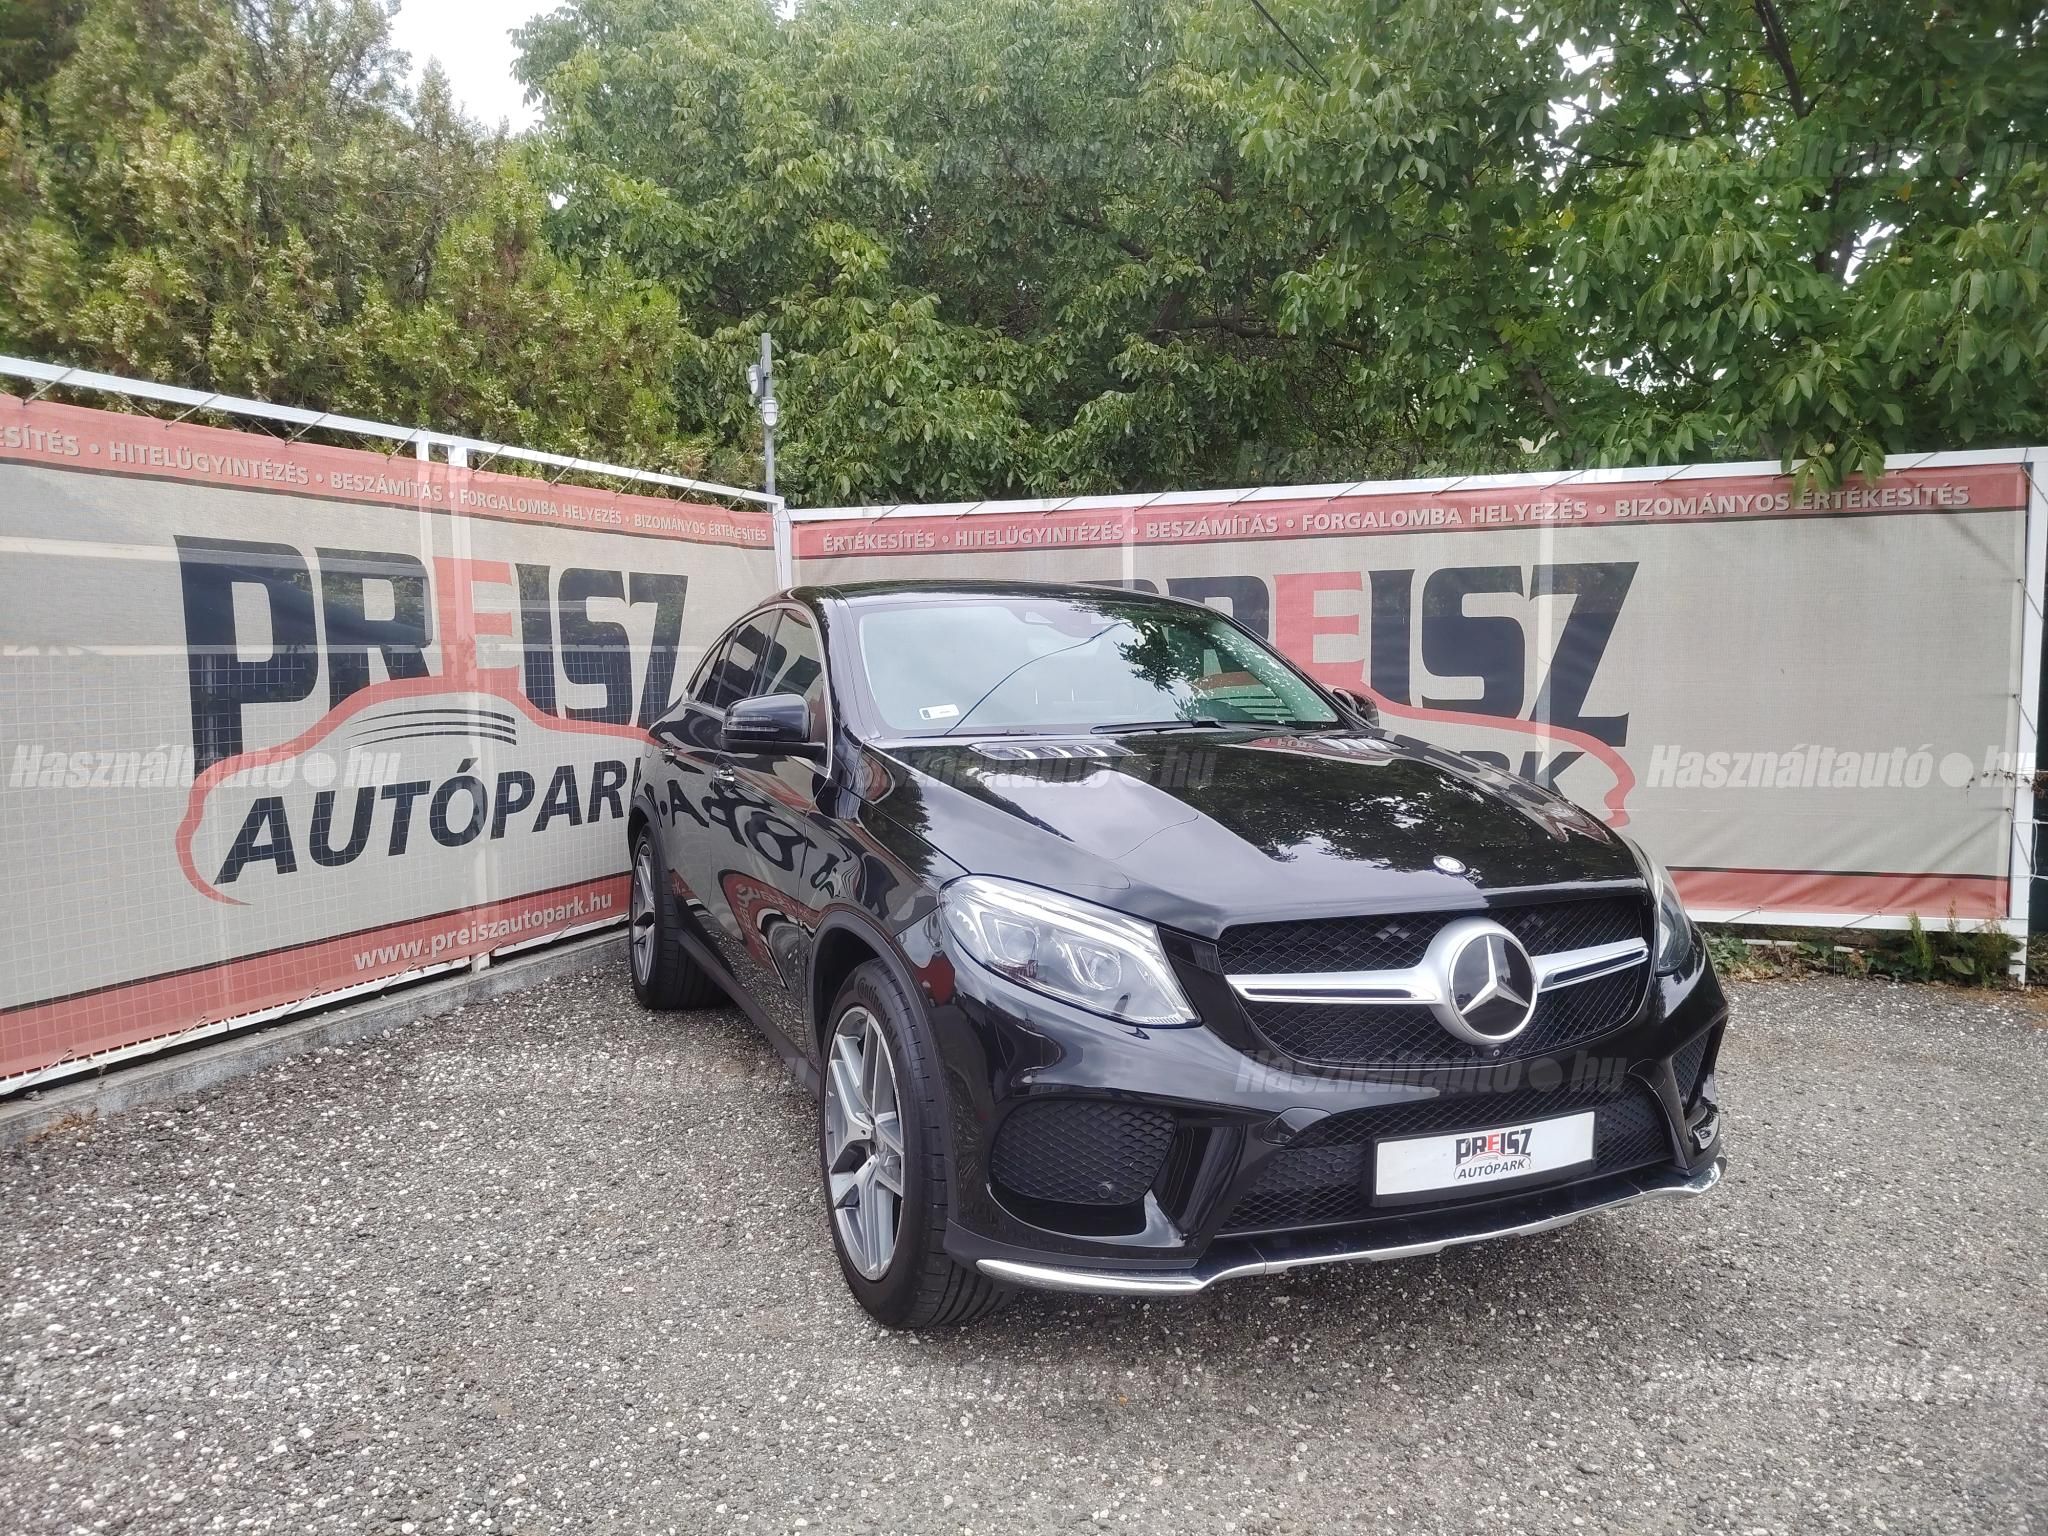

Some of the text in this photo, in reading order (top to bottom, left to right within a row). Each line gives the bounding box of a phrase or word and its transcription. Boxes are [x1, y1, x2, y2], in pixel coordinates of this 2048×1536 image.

[109, 441, 309, 486] HITELÜGYINTÉZÉS
[330, 470, 443, 501] BESZÁMÍTÁS
[459, 489, 560, 517] FORGALOMBA
[562, 504, 622, 525] HELYEZÉS
[634, 514, 706, 536] BIZOMÁNYOS
[708, 521, 767, 542] ÉRTÉKESÍTÉS
[823, 483, 1970, 553] ÉRTÉKESÍTÉS HITELÜGYINTÉZÉS BESZÁMÍTÁS FORGALOMBA HELYEZÉS BIZOMÁNYOS ÉRTÉKESÍTÉS
[354, 890, 612, 972] www.preiszautopark.hu
[1456, 1128, 1533, 1166] PREISZ
[1457, 1158, 1526, 1180] AUTÓPARK
